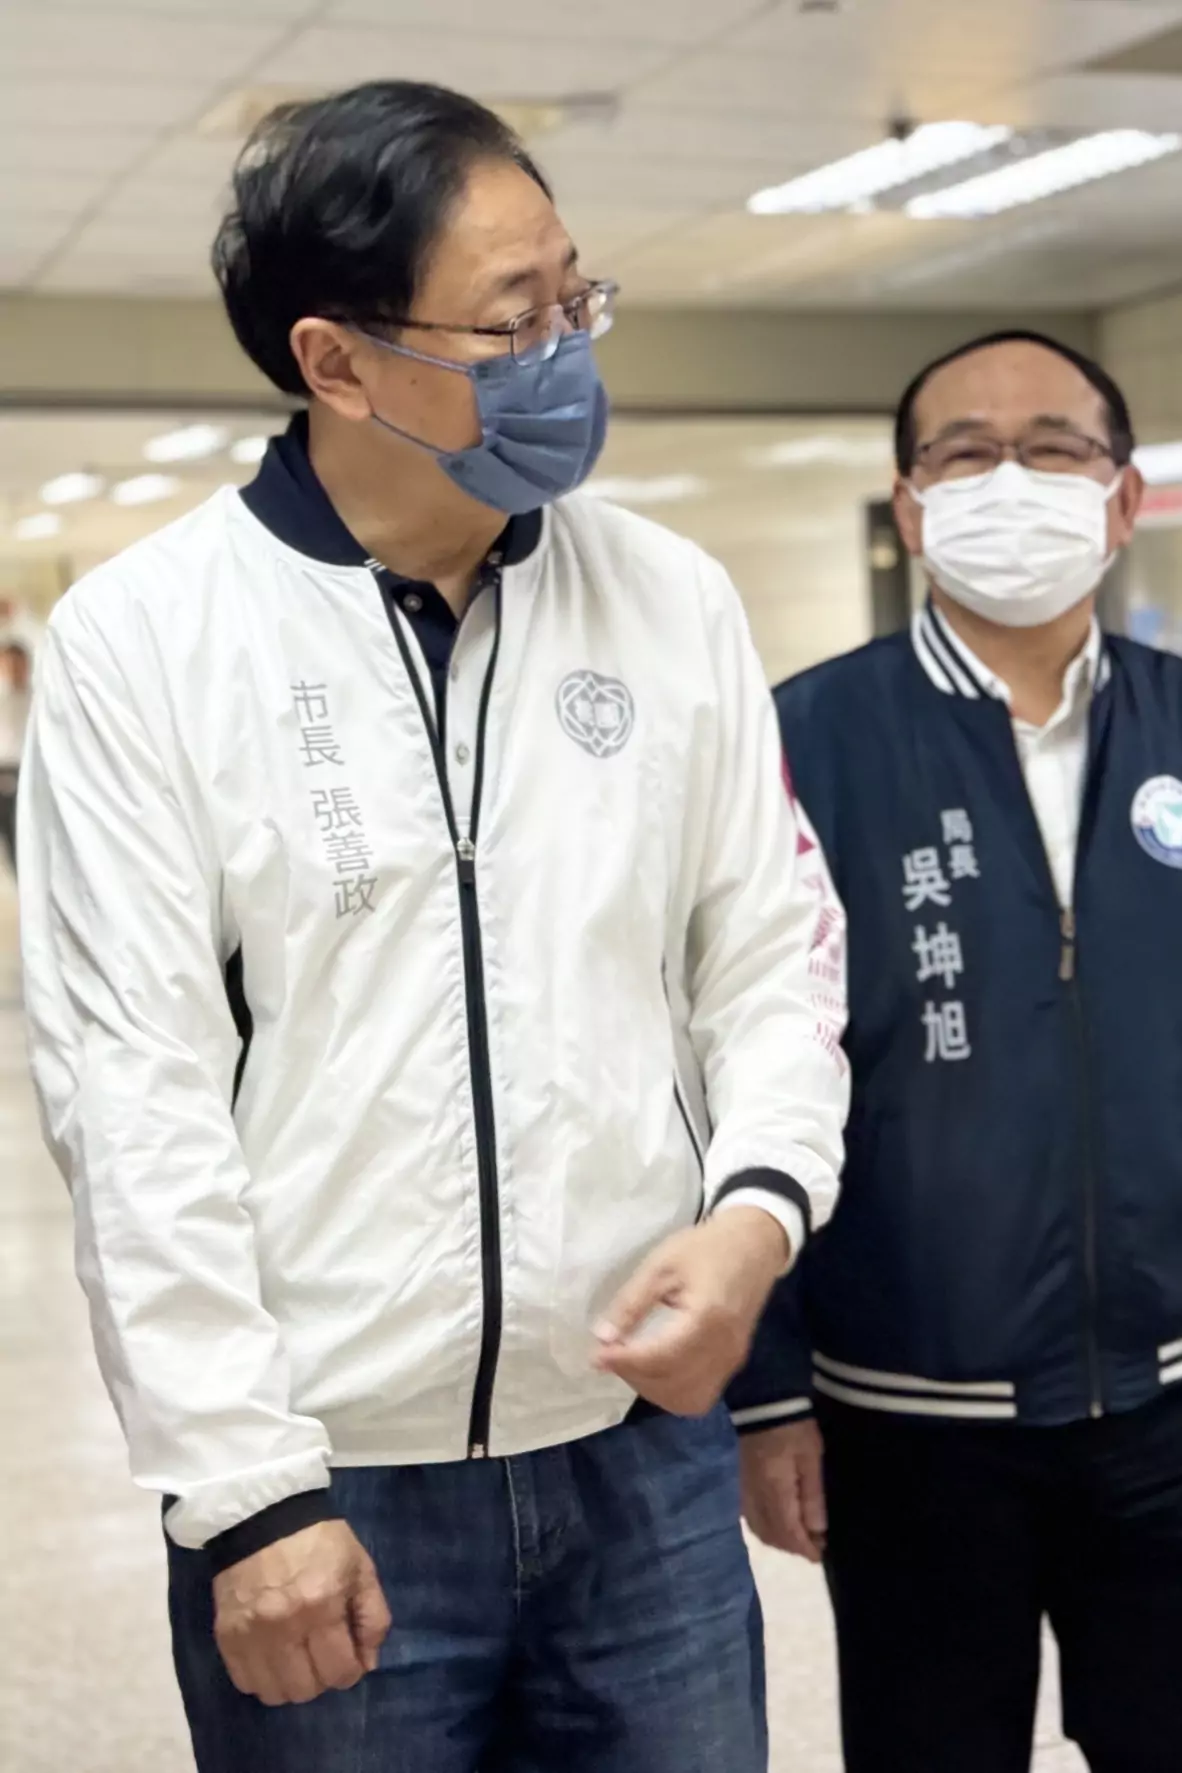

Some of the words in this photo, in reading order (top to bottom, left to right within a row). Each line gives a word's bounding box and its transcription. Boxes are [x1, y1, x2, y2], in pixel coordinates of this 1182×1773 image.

[289, 680, 345, 768] 市長
[310, 786, 379, 919] 張善政
[940, 808, 981, 879] 局長
[902, 847, 972, 1062] 吳坤旭
